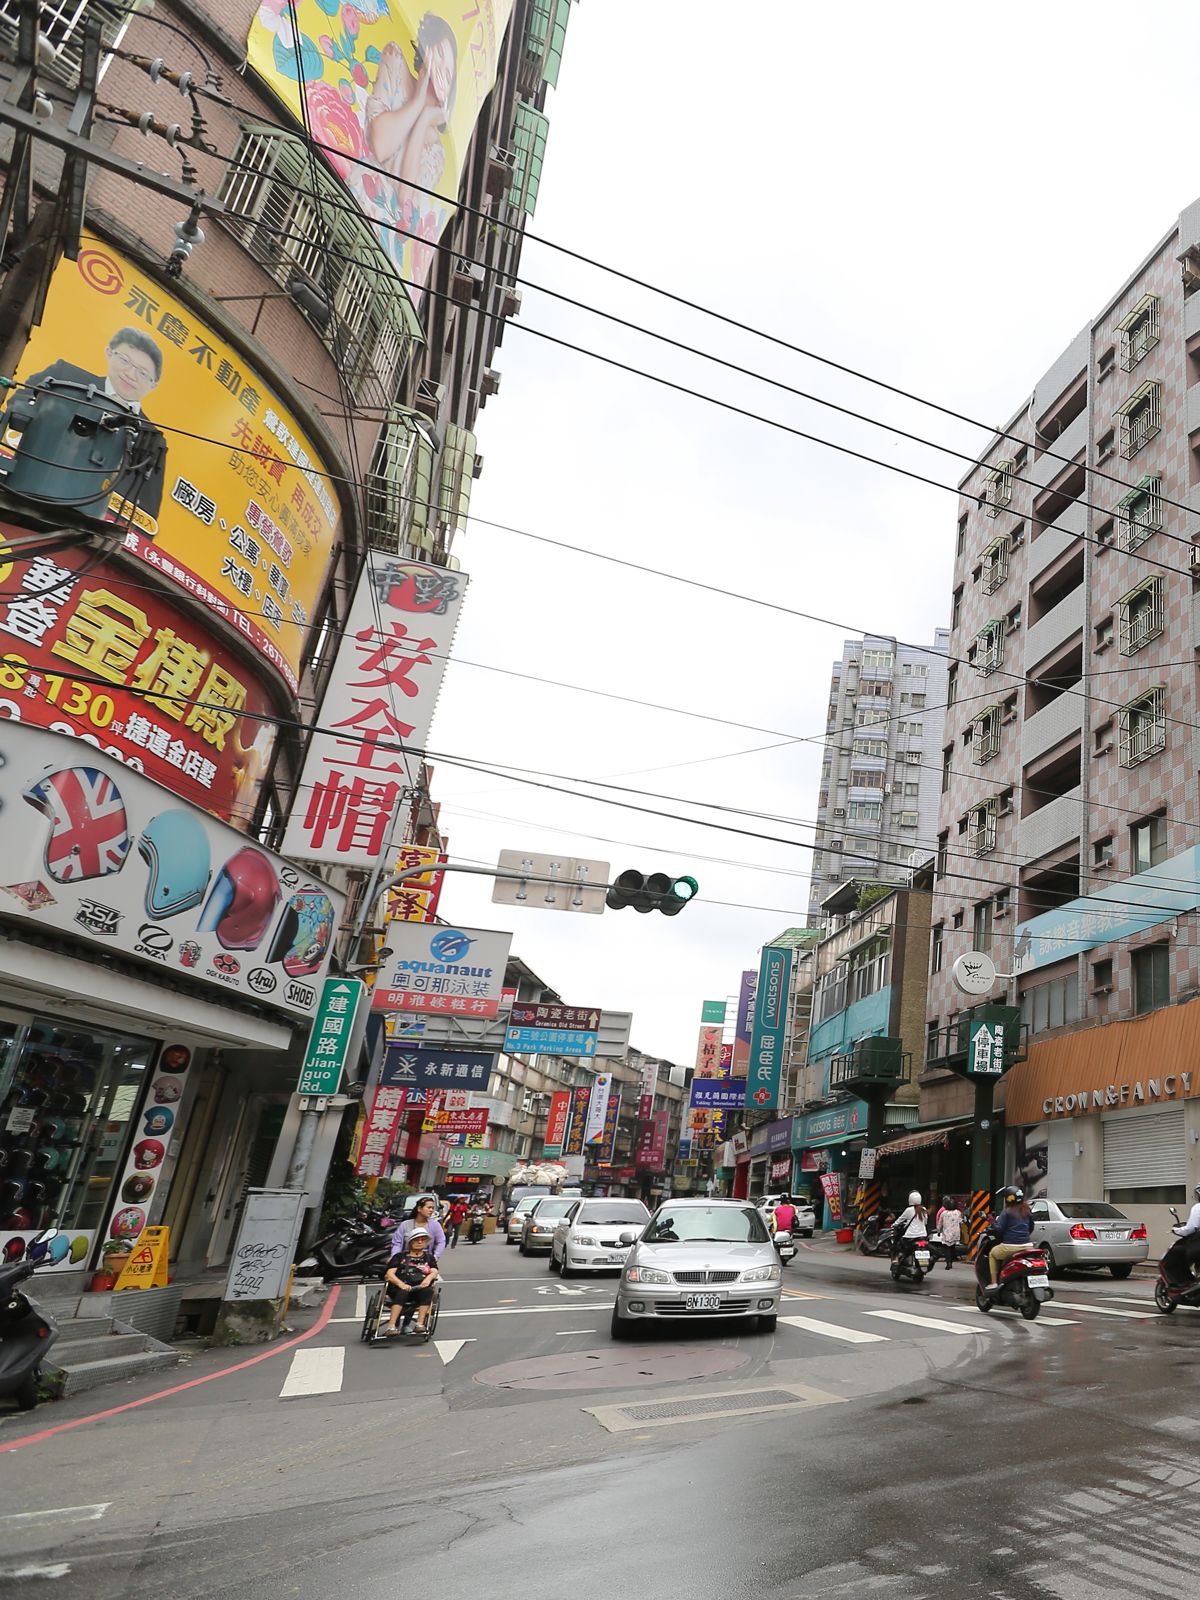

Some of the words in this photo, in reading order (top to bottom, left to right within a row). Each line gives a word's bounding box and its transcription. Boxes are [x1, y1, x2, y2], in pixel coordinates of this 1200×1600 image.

[124, 285, 262, 416] 永慶不動產
[230, 417, 289, 487] 先誠實
[290, 483, 323, 543] 再成交
[43, 673, 114, 728] 130
[110, 720, 124, 736] 坪
[123, 712, 218, 789] 捷運金店墅
[303, 621, 438, 856] 安全帽
[134, 943, 168, 961] ONZA
[218, 971, 240, 986] KABUTO
[250, 970, 275, 989] Arai
[397, 960, 493, 978] aquanaut
[287, 984, 314, 1007] SHOEI
[766, 961, 780, 1018] watsons
[536, 1007, 589, 1021] 陶瓷老街
[316, 996, 350, 1055] 建國路
[540, 1045, 563, 1053] Parking
[757, 1035, 776, 1081] 屈臣氏
[306, 1057, 341, 1068] Jian-
[424, 1062, 484, 1078] 永新通信
[304, 1070, 331, 1081] guo
[300, 1081, 322, 1093] Rd.
[358, 1087, 403, 1176] 結束營業
[552, 1101, 568, 1143] 中信房屋
